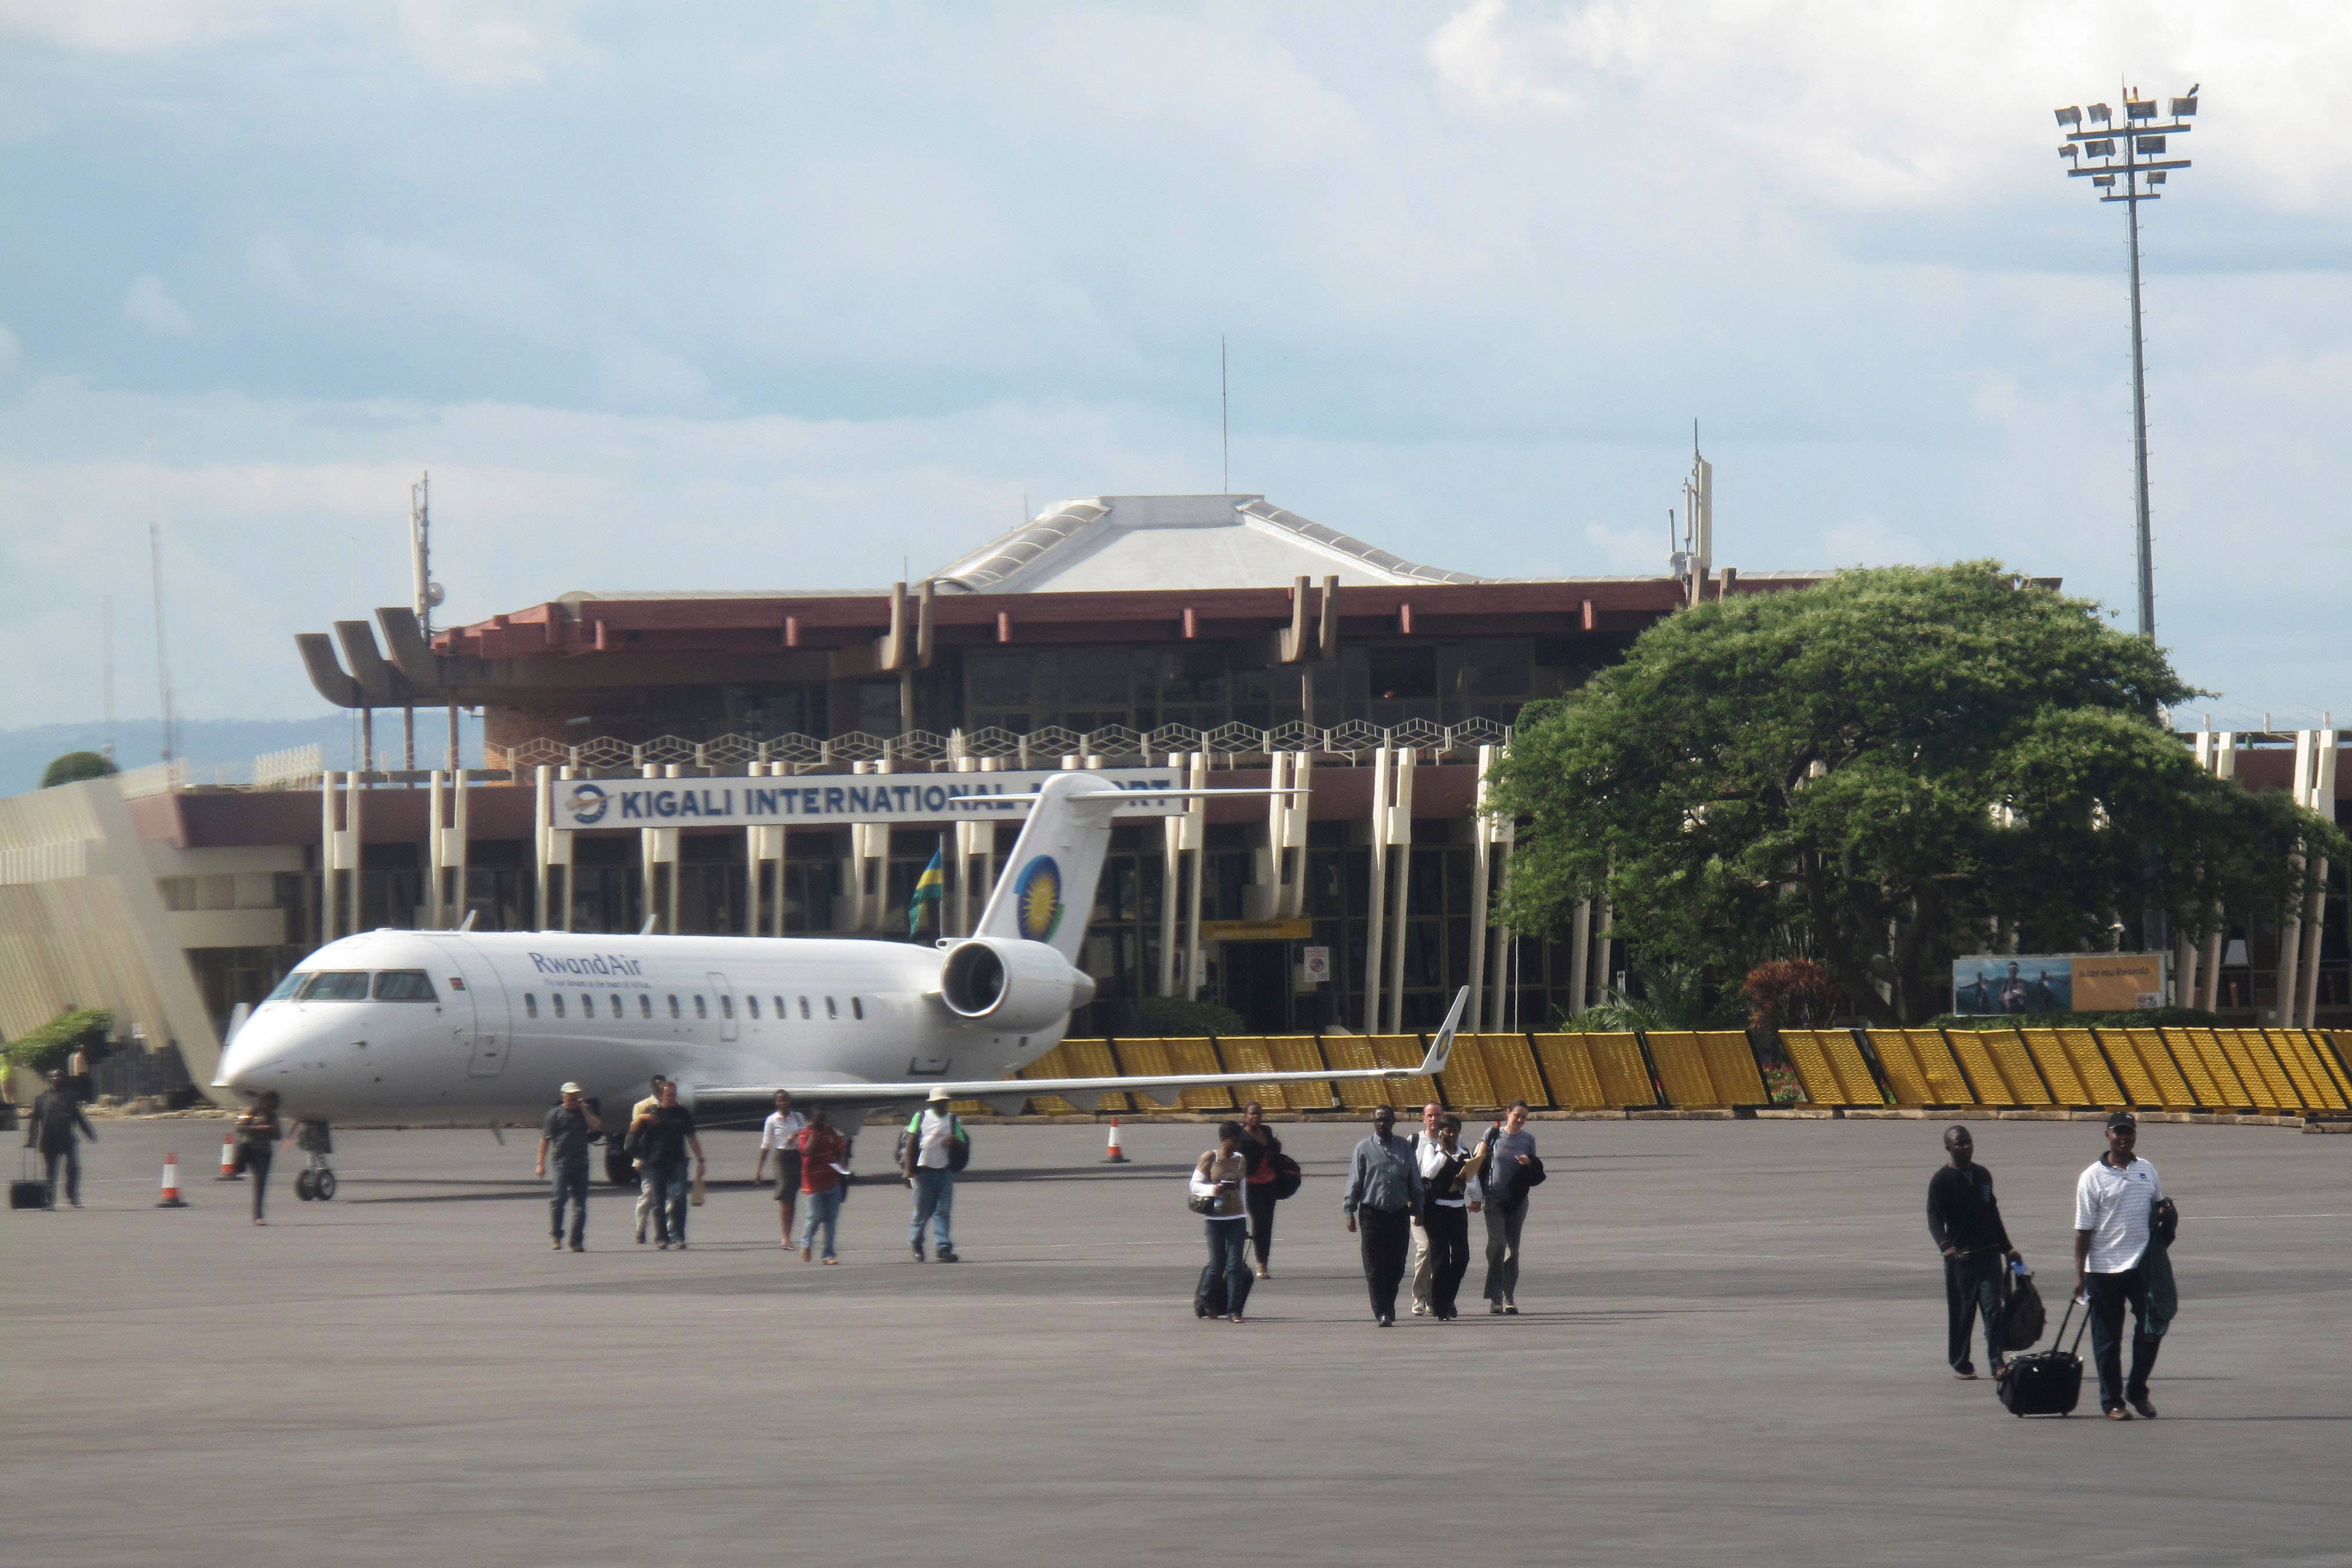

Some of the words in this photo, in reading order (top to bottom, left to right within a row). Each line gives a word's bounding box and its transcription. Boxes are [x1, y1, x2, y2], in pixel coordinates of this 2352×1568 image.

[620, 789, 732, 818] KIGALI
[744, 783, 1014, 816] INTERNATIONAL
[528, 952, 642, 976] RwandAir
[2116, 966, 2150, 976] Rwanda
